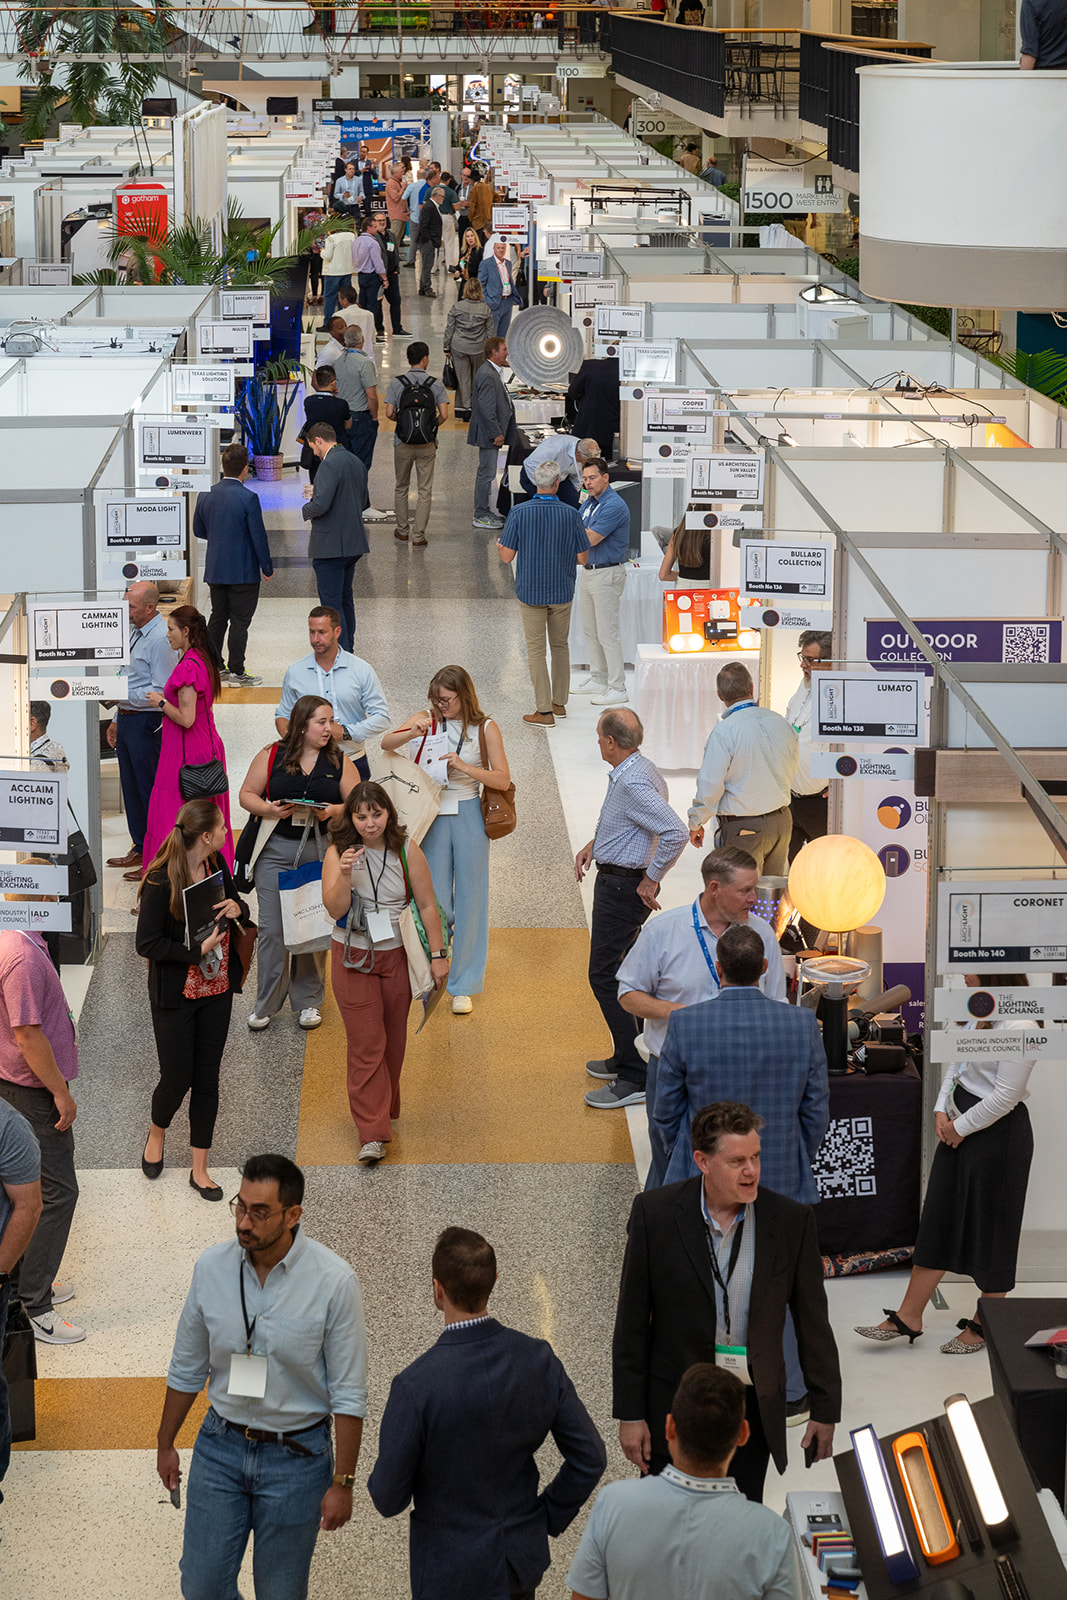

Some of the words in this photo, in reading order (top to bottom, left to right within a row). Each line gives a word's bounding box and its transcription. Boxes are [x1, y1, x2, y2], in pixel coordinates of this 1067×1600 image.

[558, 68, 579, 76] 1100
[132, 195, 159, 204] gotham
[744, 192, 793, 209] 1500
[880, 652, 952, 661] COLLECON
[11, 784, 54, 794] ACCLAIM
[9, 795, 54, 806] LIGHTING
[1013, 898, 1064, 907] CORONET
